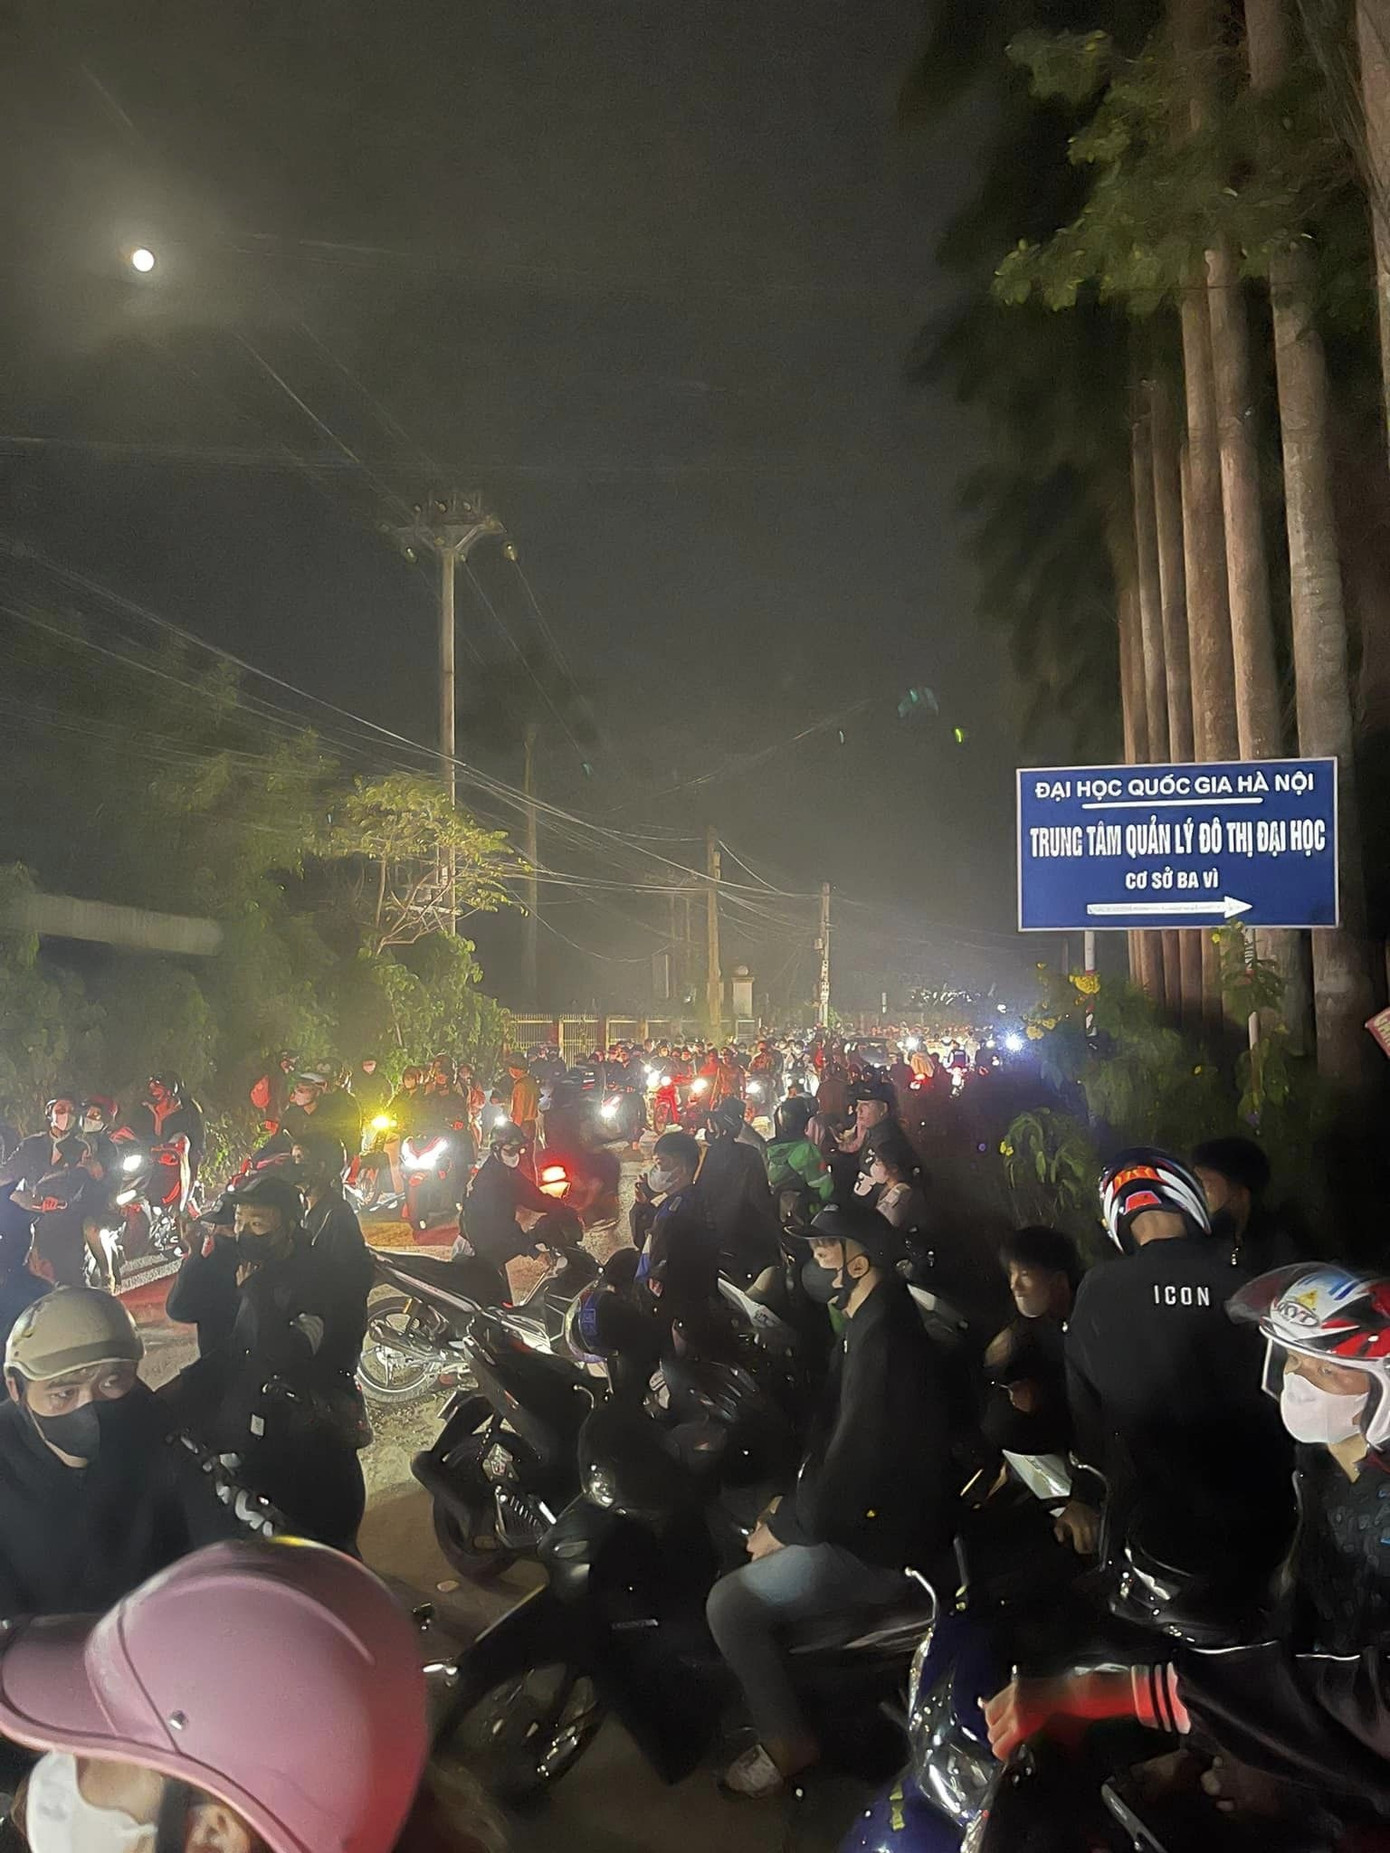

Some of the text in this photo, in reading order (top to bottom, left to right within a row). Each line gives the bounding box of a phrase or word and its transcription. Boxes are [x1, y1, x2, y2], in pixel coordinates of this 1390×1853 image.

[1035, 770, 1314, 802] ĐẠI HỌC QUỐC GIA HÀ NỘI
[1030, 815, 1326, 859] TRUNG TÂM QUẢN LÝ ĐÔ THỊ ĐẠI HỌC
[1125, 866, 1219, 890] CƠ SỞ BA VÌ
[1153, 1284, 1210, 1307] ICON
